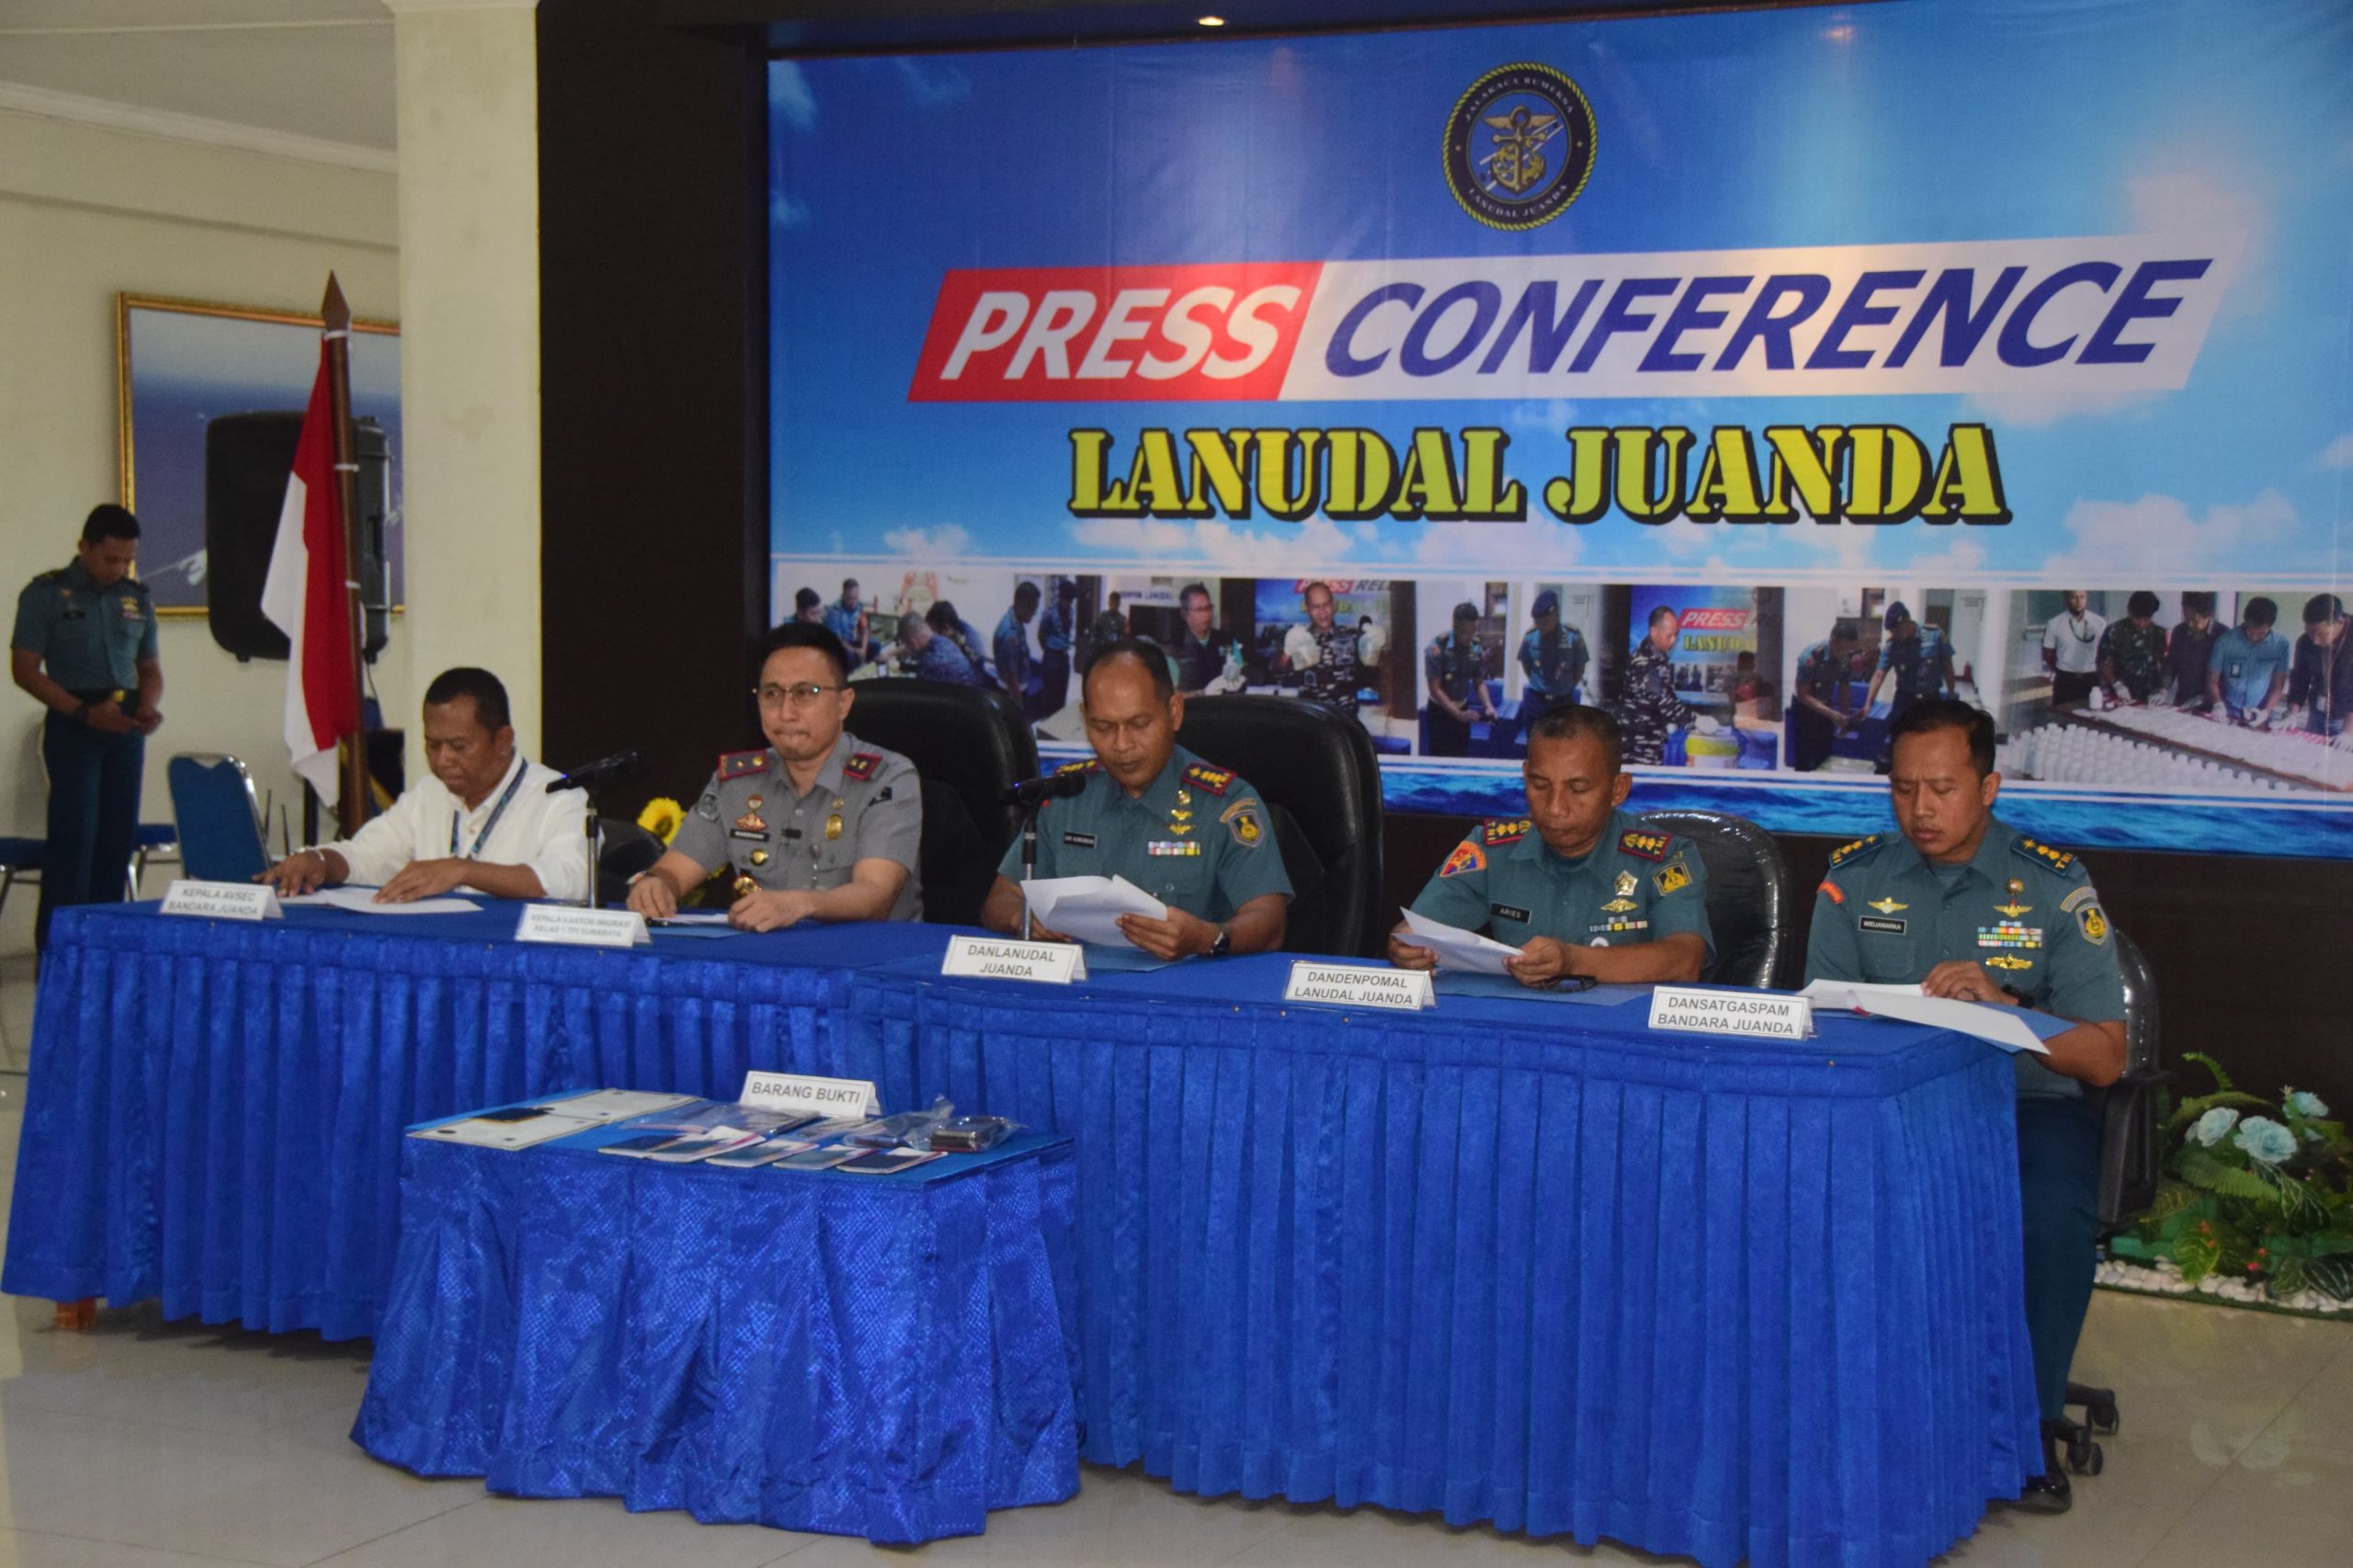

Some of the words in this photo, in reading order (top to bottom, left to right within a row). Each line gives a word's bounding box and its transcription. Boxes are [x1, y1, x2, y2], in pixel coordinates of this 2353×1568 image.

[1468, 187, 1519, 218] LANUDAL
[1522, 184, 1568, 217] JUANDA
[938, 284, 1302, 381] PRESS
[1324, 258, 2213, 378] CONFERENCE
[1067, 426, 1528, 522] LANUDAL
[1543, 423, 2014, 525] JUANDA
[1681, 611, 1746, 628] PRESS
[183, 887, 221, 898] KEPALA
[223, 891, 256, 902] AVSEC
[167, 901, 216, 912] BANDARA
[217, 904, 258, 915] JUANDA
[968, 944, 1056, 962] DANLANUDAL
[980, 962, 1033, 977] JUANDA
[1307, 971, 1408, 988] DANDENPOMAL
[1294, 986, 1355, 1001] LANUDAL
[1358, 991, 1413, 1005] JUANDA
[1668, 996, 1790, 1017] DANSATGASPAM
[1657, 1013, 1729, 1029] BANDARA
[1733, 1018, 1793, 1034] JUANDA
[751, 1081, 813, 1099] BARANG
[815, 1087, 860, 1104] BUKTI
